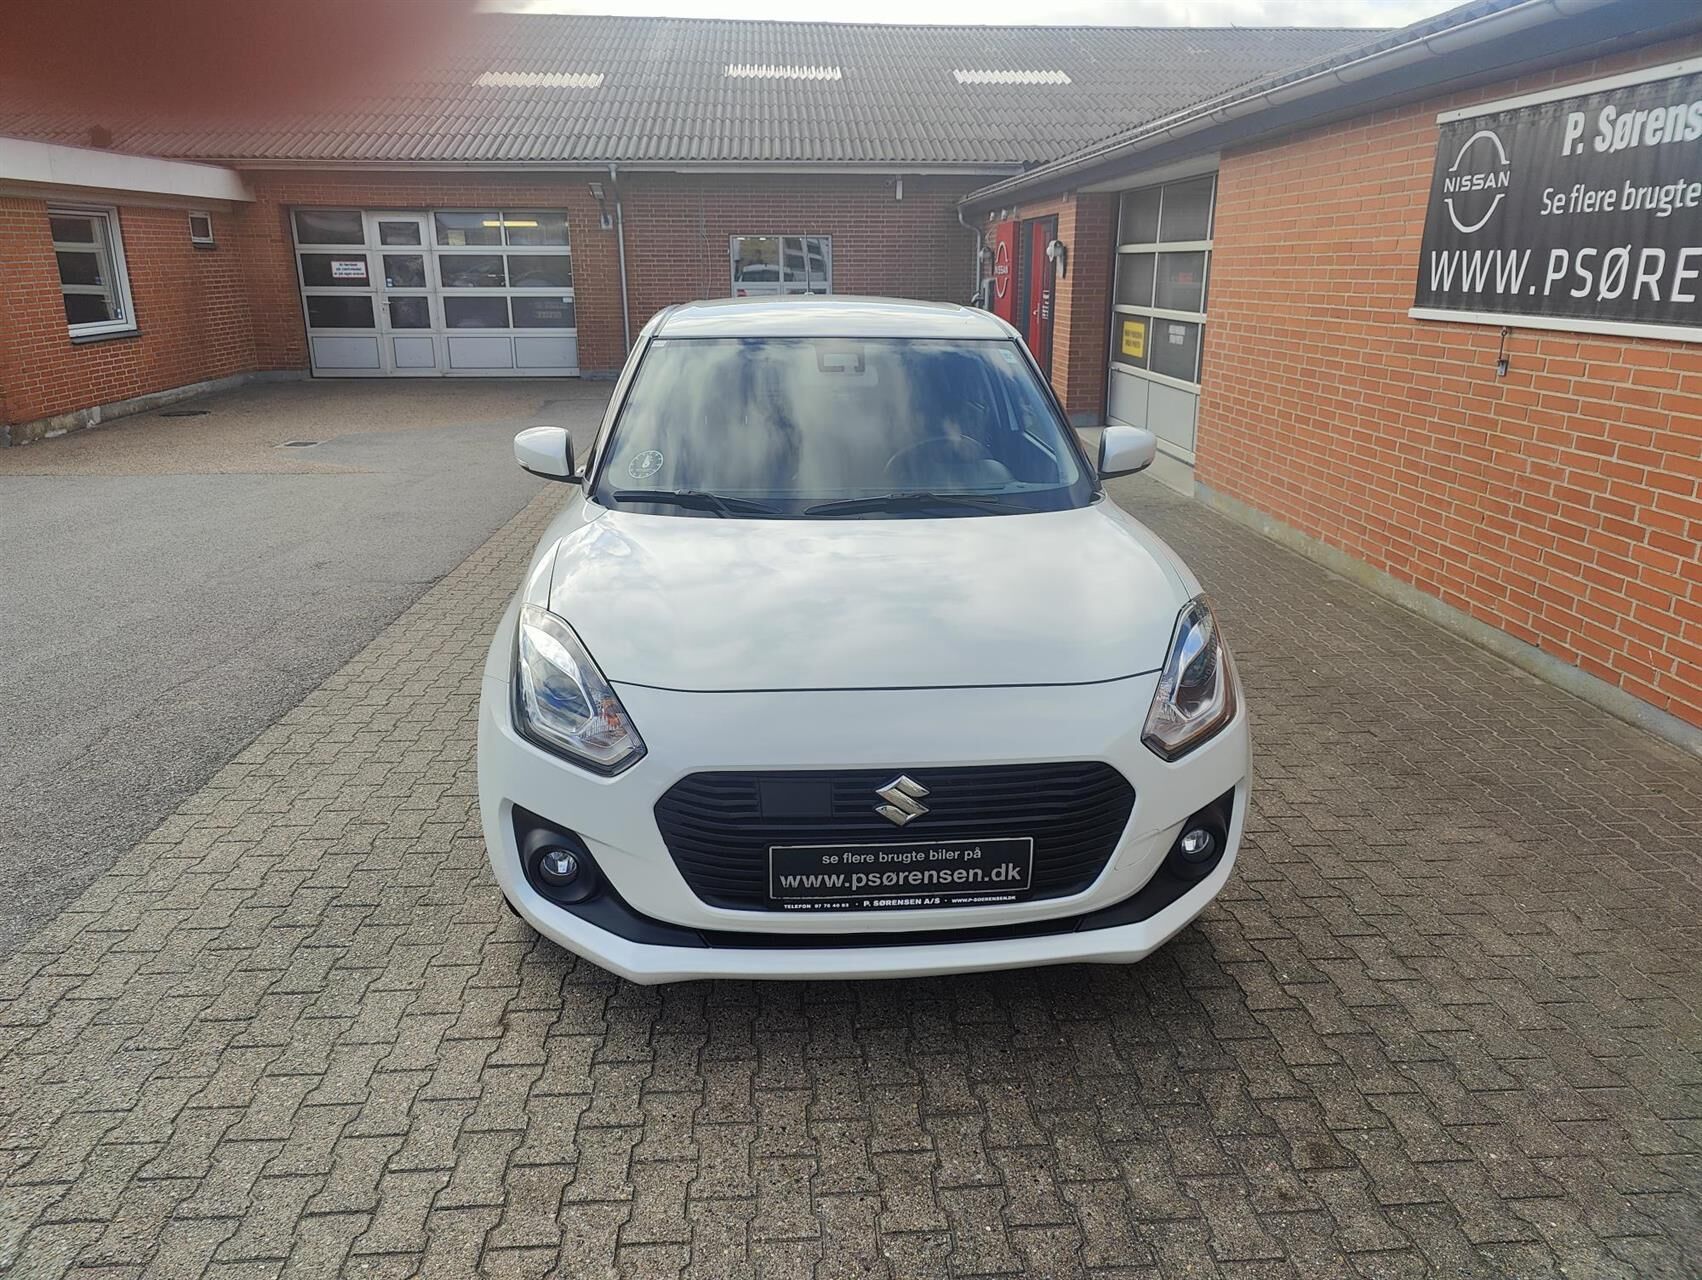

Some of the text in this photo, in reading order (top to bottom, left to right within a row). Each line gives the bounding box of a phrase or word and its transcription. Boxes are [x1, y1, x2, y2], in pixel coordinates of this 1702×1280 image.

[1562, 102, 1702, 156] P. Sørens
[1444, 171, 1511, 193] NISSAN
[1541, 178, 1702, 217] Se flere brugte
[1430, 245, 1702, 303] WWW.PSØRE
[822, 847, 982, 864] se flere brugte biler på
[779, 863, 1021, 891] www.psørensen.dk
[873, 898, 922, 906] SØRENSEN
